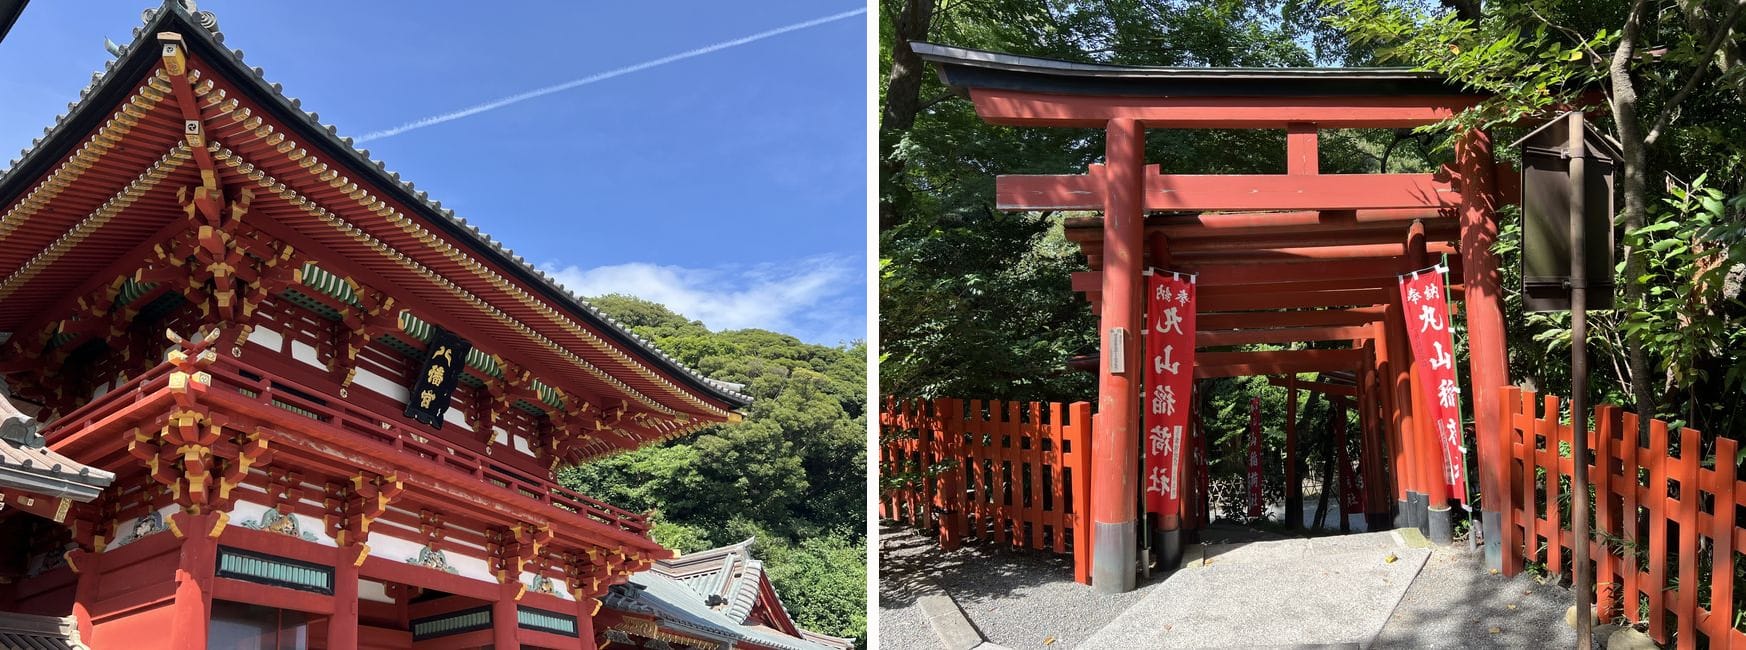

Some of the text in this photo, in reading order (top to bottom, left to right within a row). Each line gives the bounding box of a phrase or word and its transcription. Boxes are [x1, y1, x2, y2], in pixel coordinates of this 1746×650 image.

[1407, 283, 1440, 304] 奉納
[420, 346, 453, 409] 八幡宮
